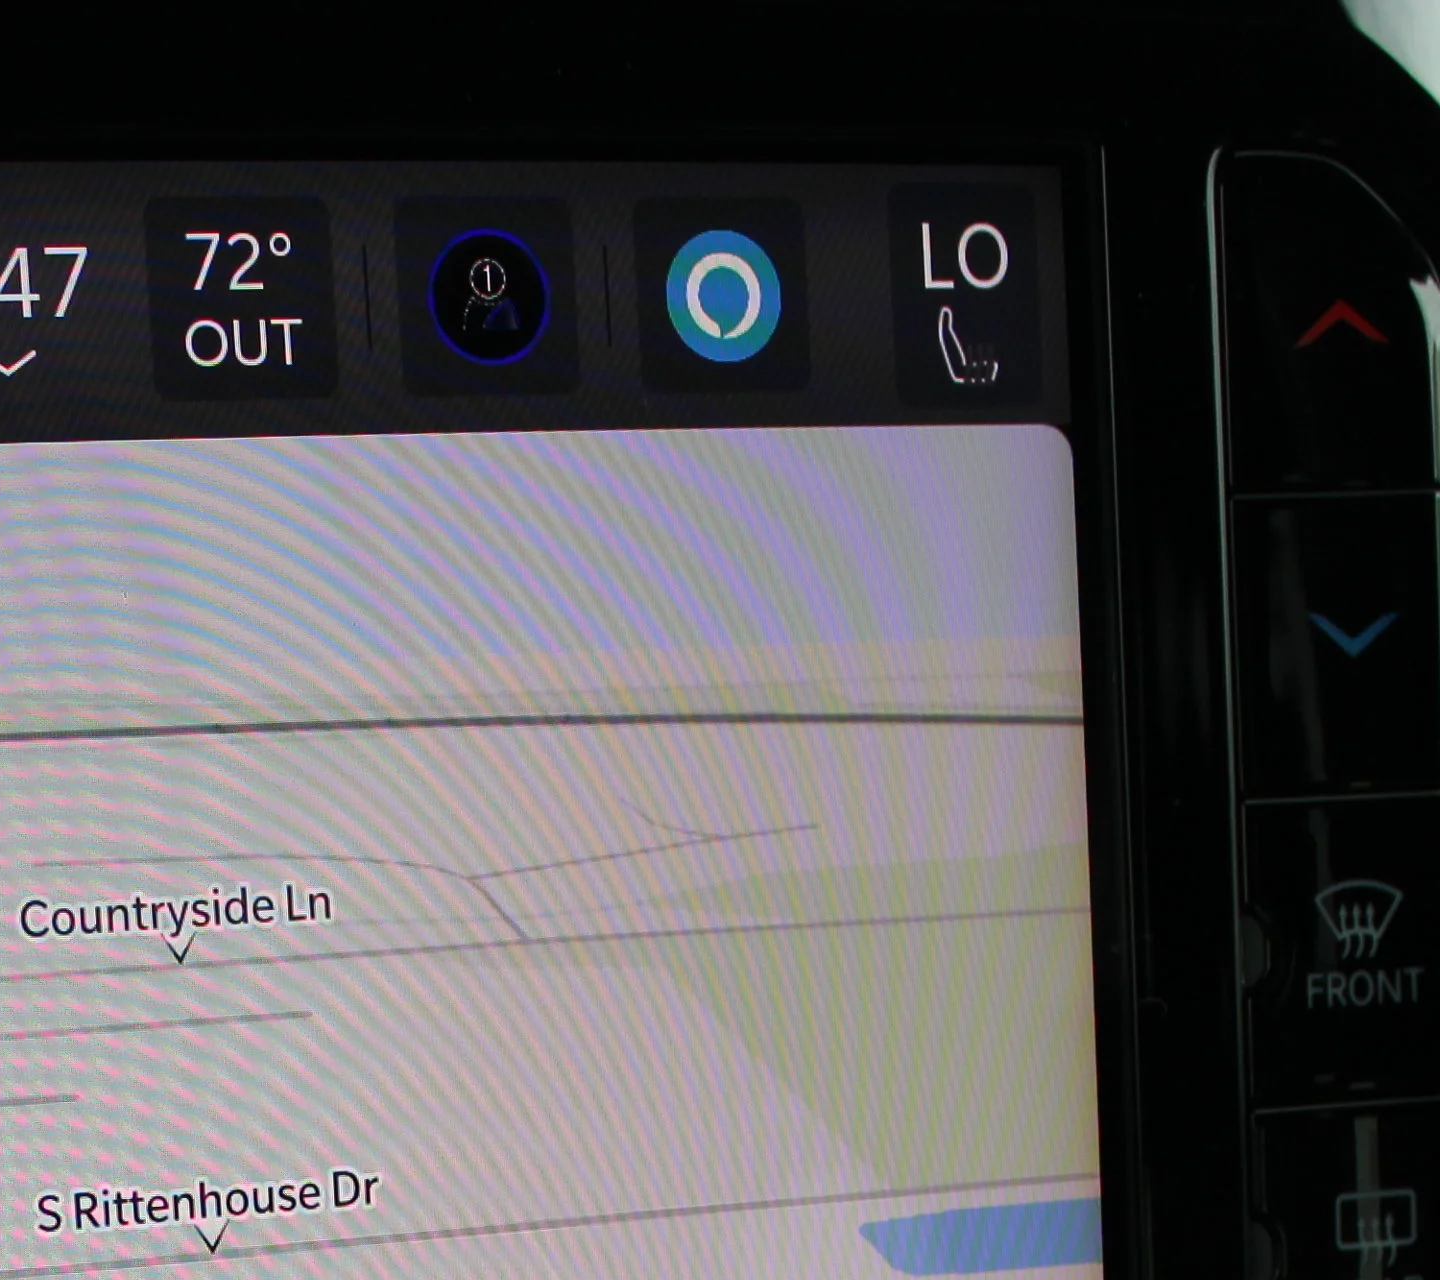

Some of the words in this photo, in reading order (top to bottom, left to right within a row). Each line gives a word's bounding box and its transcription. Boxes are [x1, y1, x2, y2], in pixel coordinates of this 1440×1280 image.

[183, 231, 293, 292] 72°
[921, 221, 1010, 290] LO
[184, 317, 304, 368] OUT
[20, 887, 275, 937] Countryside
[285, 885, 332, 922] Ln
[1306, 966, 1426, 1009] FRONT
[37, 1194, 62, 1231] S
[74, 1179, 321, 1229] Rittenhouse
[333, 1170, 379, 1208] Dr
